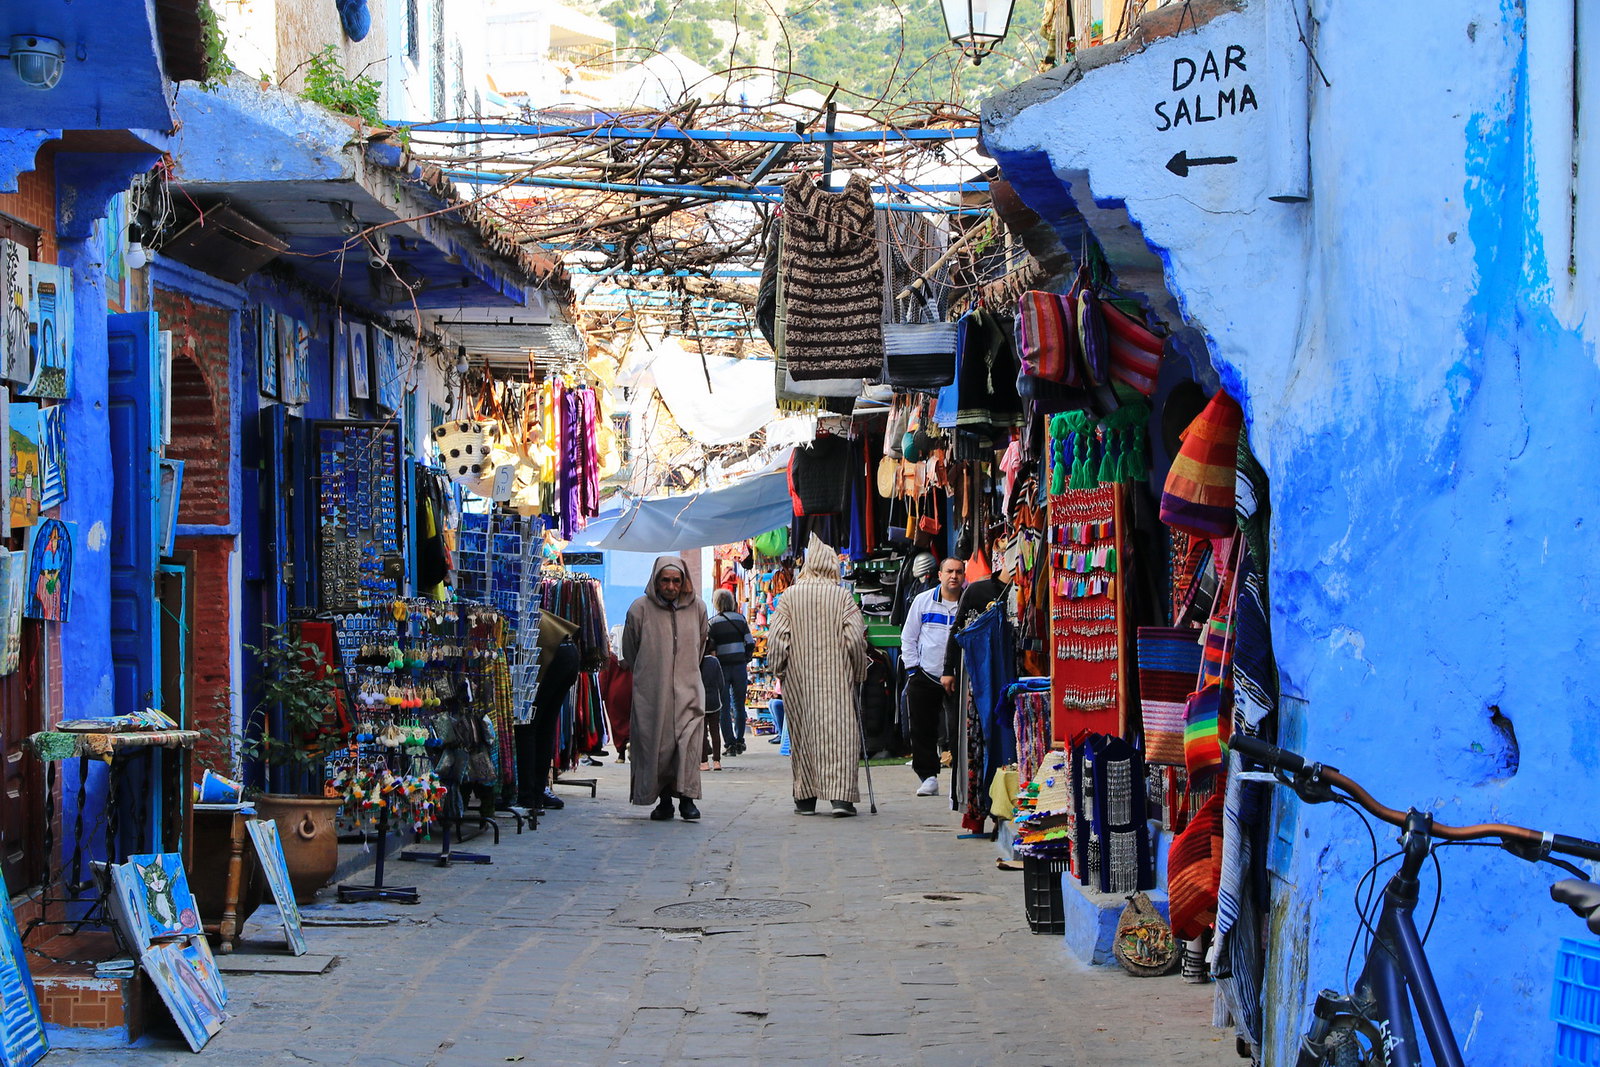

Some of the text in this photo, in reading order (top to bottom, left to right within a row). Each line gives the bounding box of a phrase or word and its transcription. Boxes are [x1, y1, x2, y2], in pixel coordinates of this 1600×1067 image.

[1173, 45, 1247, 91] DAR
[1154, 84, 1258, 131] SALMA
[496, 485, 506, 495] DH
[501, 467, 509, 485] 5
